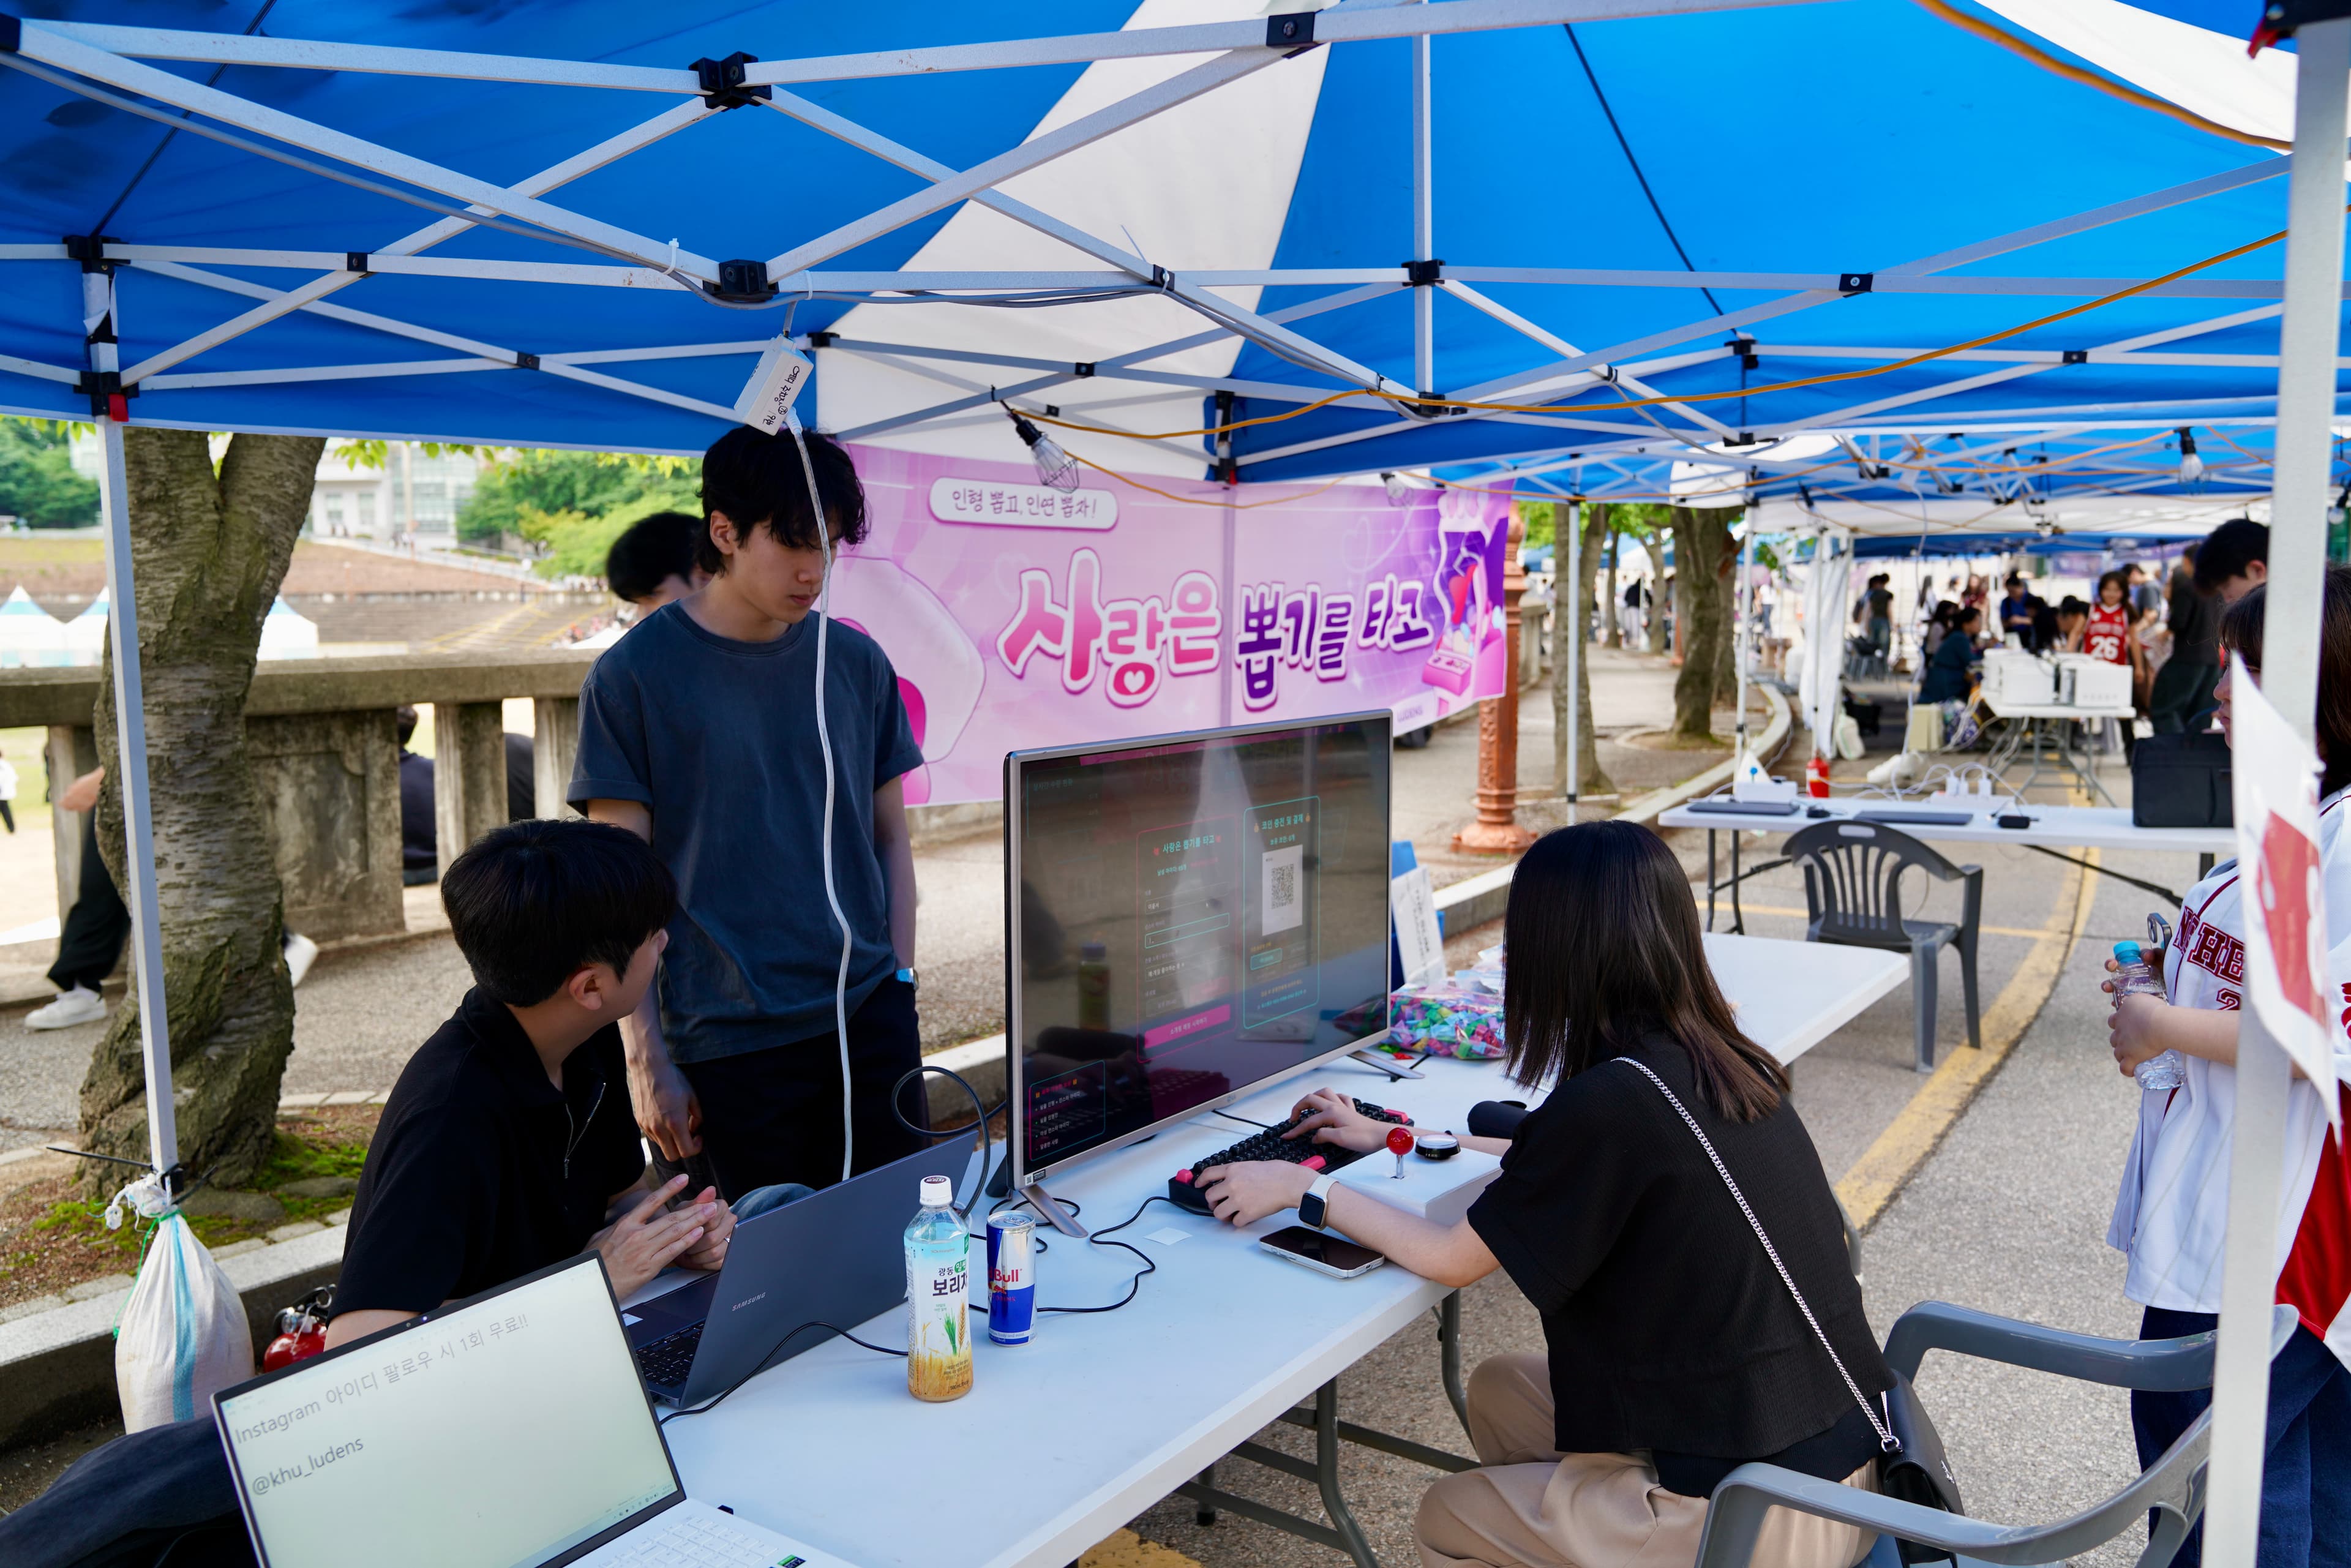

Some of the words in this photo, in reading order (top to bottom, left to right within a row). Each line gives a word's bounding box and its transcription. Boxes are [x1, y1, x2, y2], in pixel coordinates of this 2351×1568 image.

[952, 489, 983, 513] 인형
[989, 490, 1024, 518] 뽑고,
[1026, 492, 1056, 518] 인연
[1060, 492, 1098, 520] 뽑자!
[997, 549, 1221, 706] 사랑은
[1235, 583, 1351, 710] 뽑기를
[1358, 573, 1433, 652] 타고
[2090, 635, 2120, 661] 26
[1262, 819, 1272, 829] 코인
[1163, 841, 1181, 854] 사랑은
[1183, 837, 1201, 850] 뽑기를
[1202, 834, 1215, 846] 타고
[932, 1271, 967, 1296] 보리차
[938, 1266, 954, 1277] 광동
[994, 1268, 1019, 1283] Bull
[732, 1291, 767, 1311] SAMSUNG
[235, 1399, 321, 1444] Instagram
[325, 1371, 379, 1405] 아이디
[383, 1350, 434, 1384] 팔로우
[440, 1341, 456, 1360] 시
[460, 1328, 486, 1352] 1회
[489, 1313, 530, 1340] 무료!!
[252, 1437, 365, 1496] @khu_ludens
